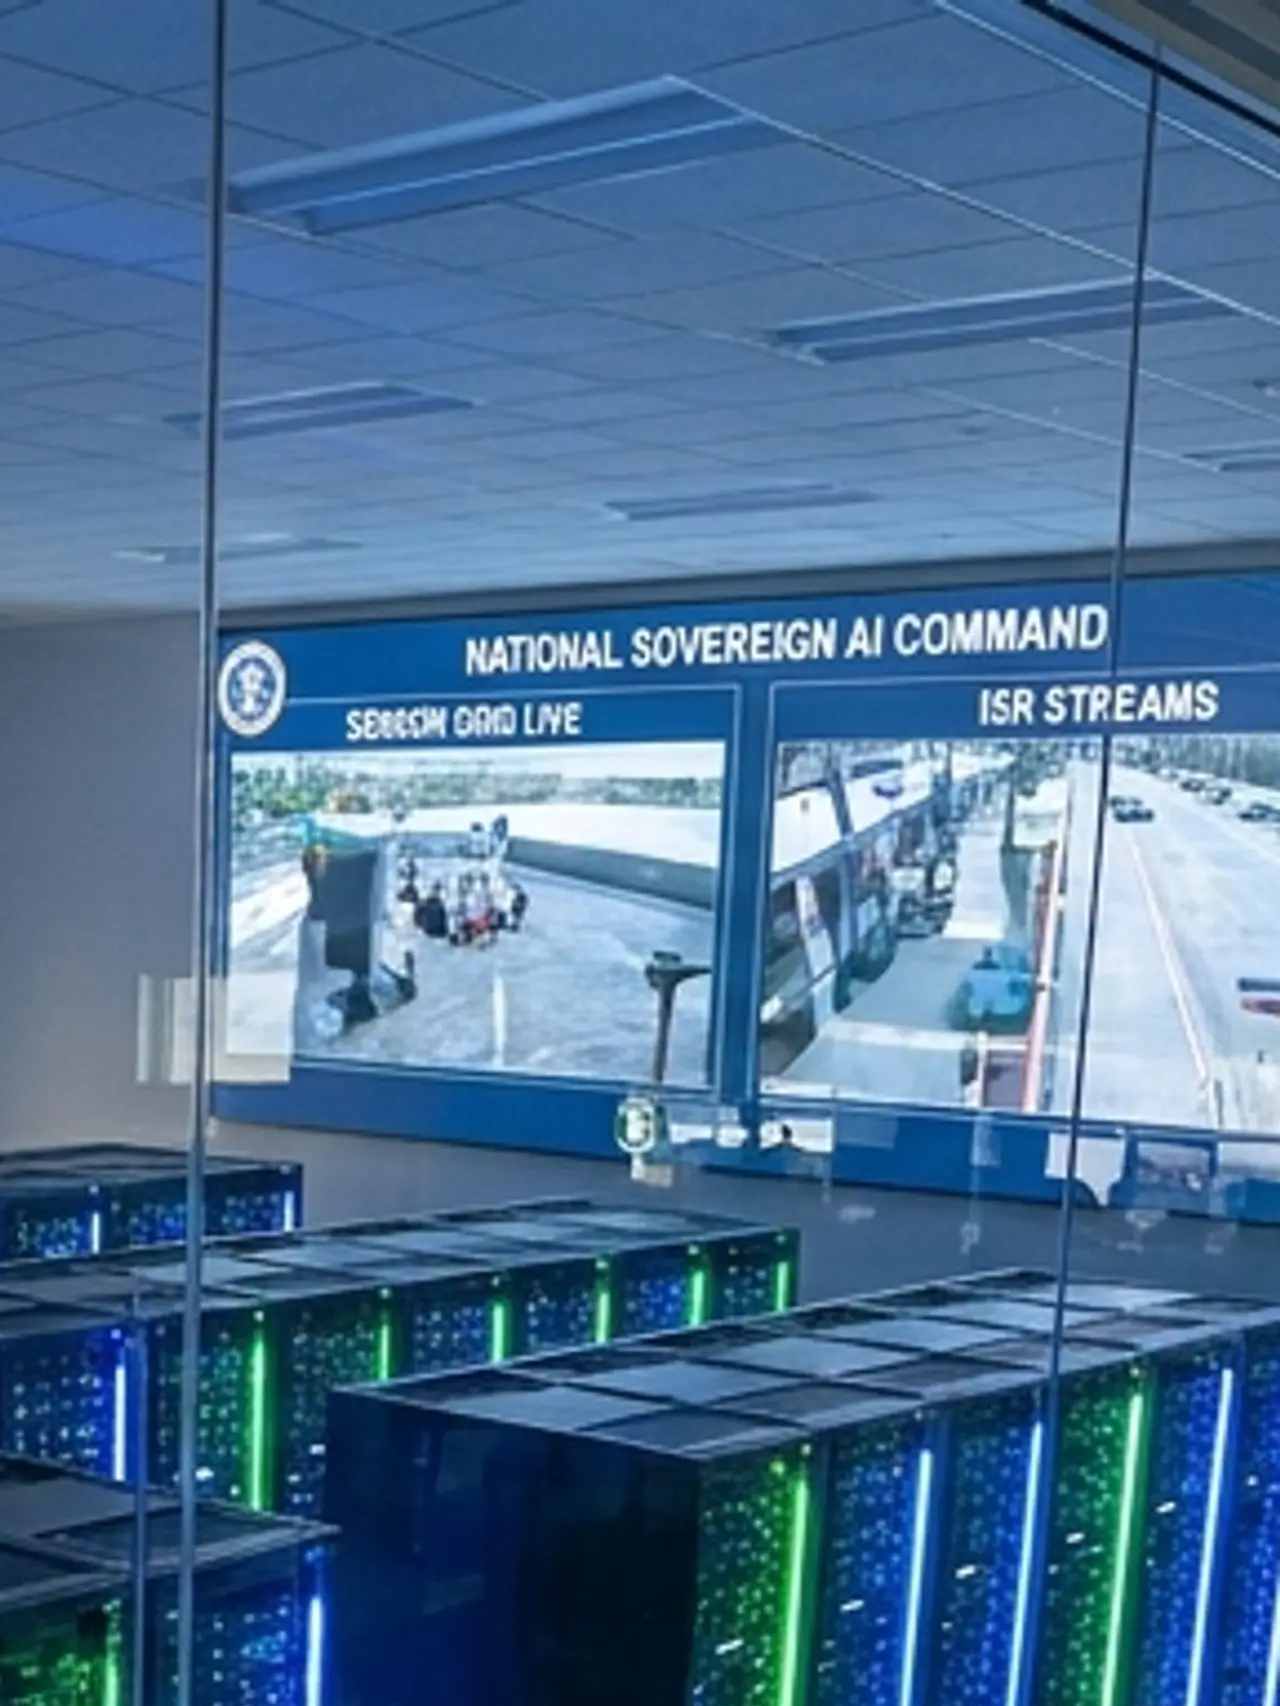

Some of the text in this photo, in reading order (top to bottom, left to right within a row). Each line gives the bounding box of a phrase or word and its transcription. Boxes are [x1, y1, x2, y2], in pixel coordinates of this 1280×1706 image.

[465, 603, 1109, 675] NATIONAL SOVEREIGN AI COMMAND
[978, 681, 1219, 726] ISR STREAMS
